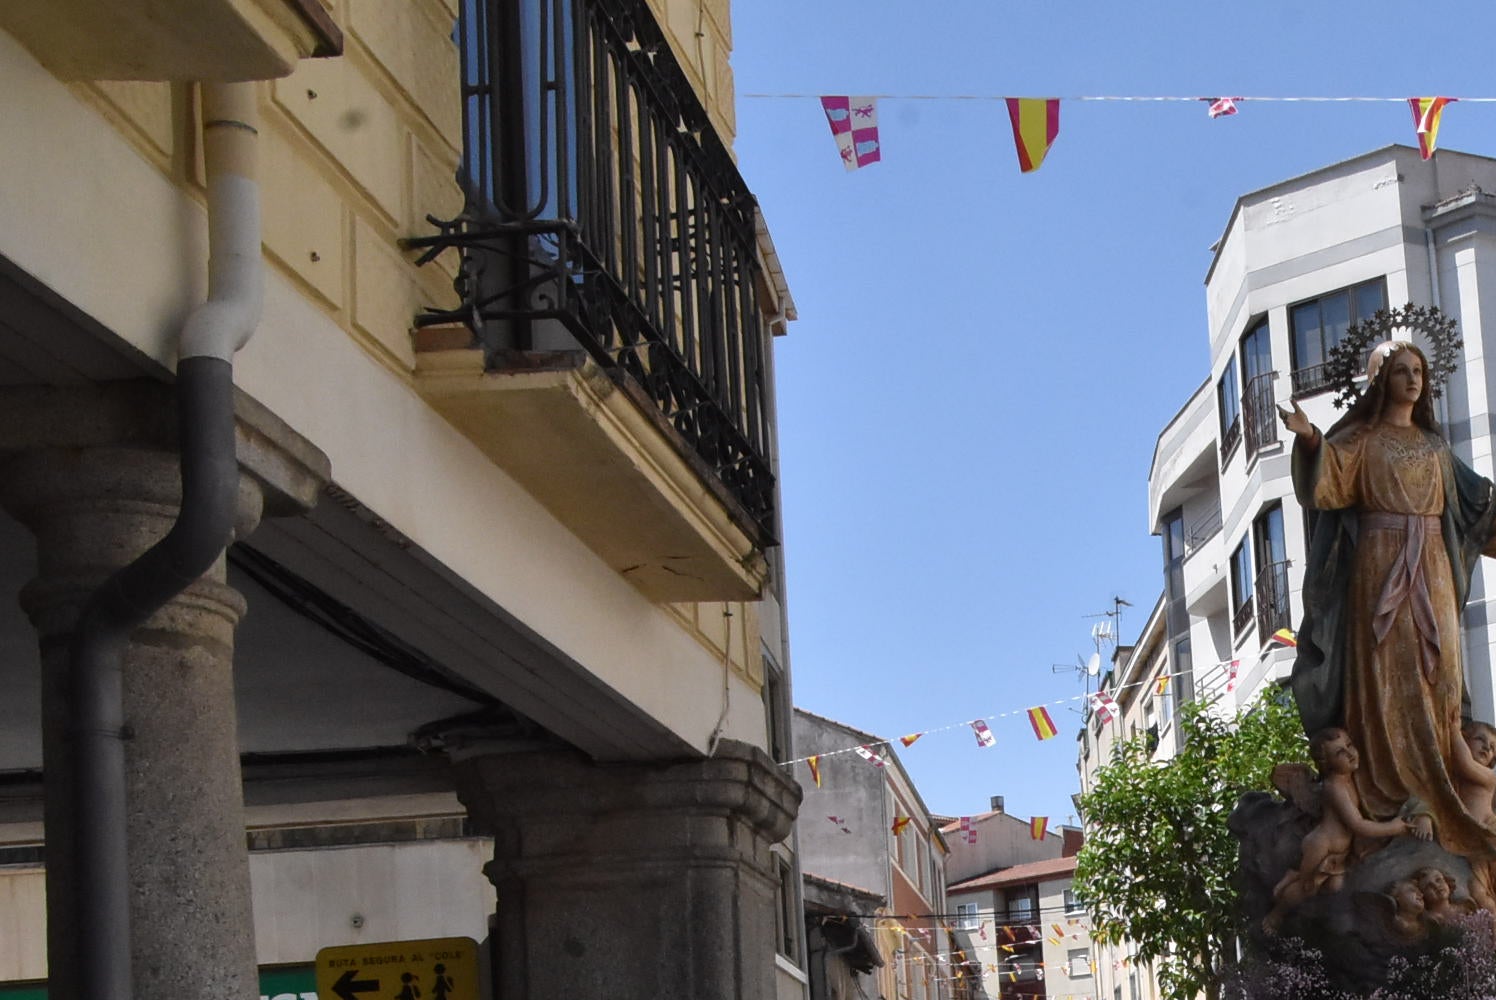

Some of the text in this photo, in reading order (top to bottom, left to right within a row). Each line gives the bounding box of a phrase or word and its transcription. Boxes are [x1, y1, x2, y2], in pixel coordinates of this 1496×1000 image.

[328, 958, 357, 968] RUTA
[363, 955, 405, 967] SEGURA
[411, 954, 424, 963] AL
